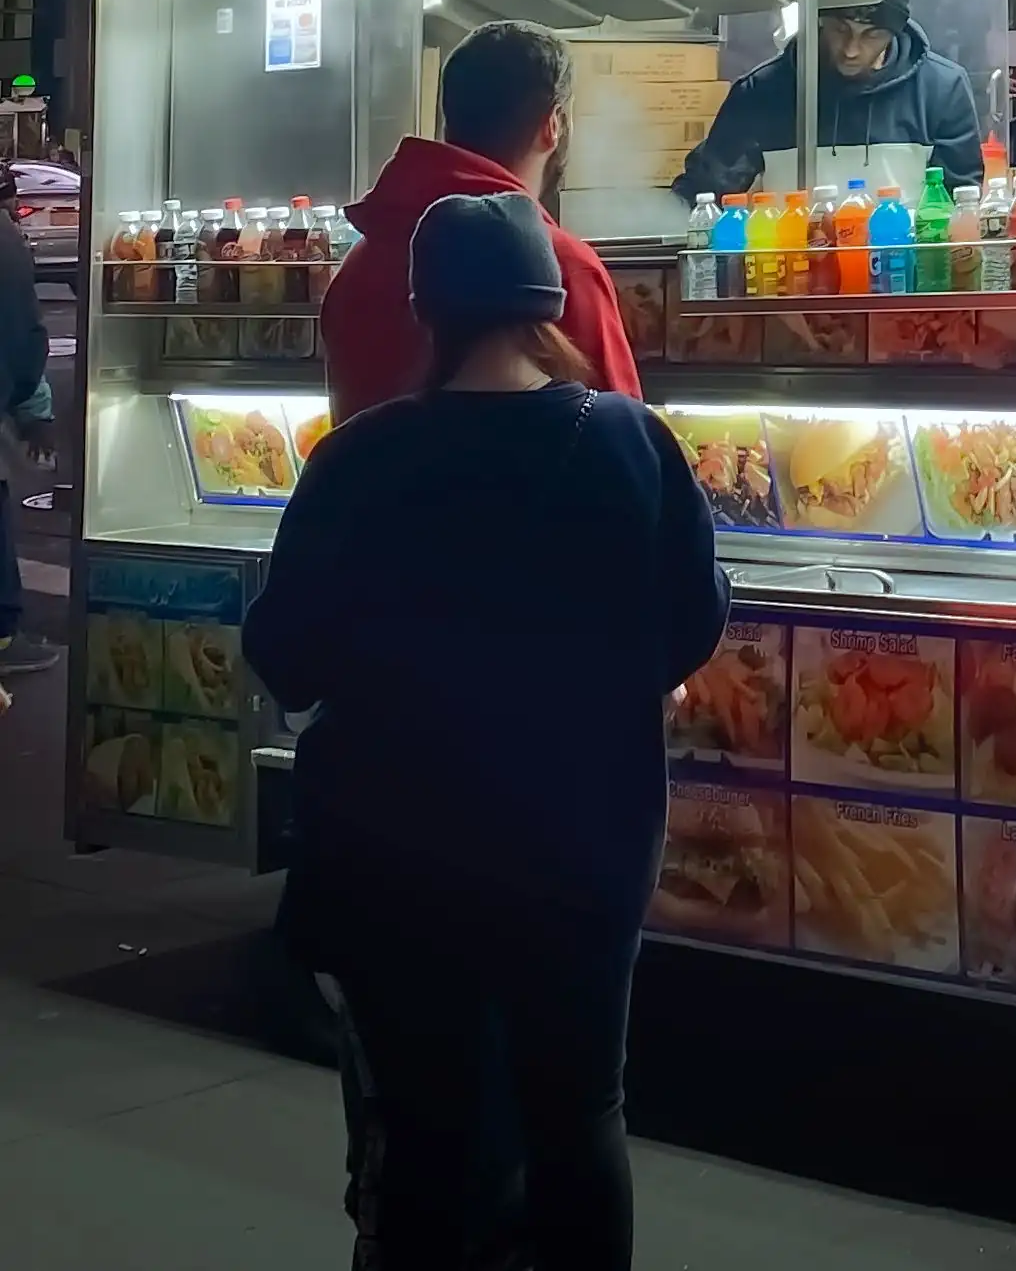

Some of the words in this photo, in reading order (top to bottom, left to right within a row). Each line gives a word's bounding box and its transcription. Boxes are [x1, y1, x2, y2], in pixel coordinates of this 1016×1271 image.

[727, 623, 762, 642] Salad
[831, 630, 876, 654] Shrimp
[879, 633, 918, 655] Salad
[835, 801, 881, 825] French
[883, 806, 919, 828] Fries
